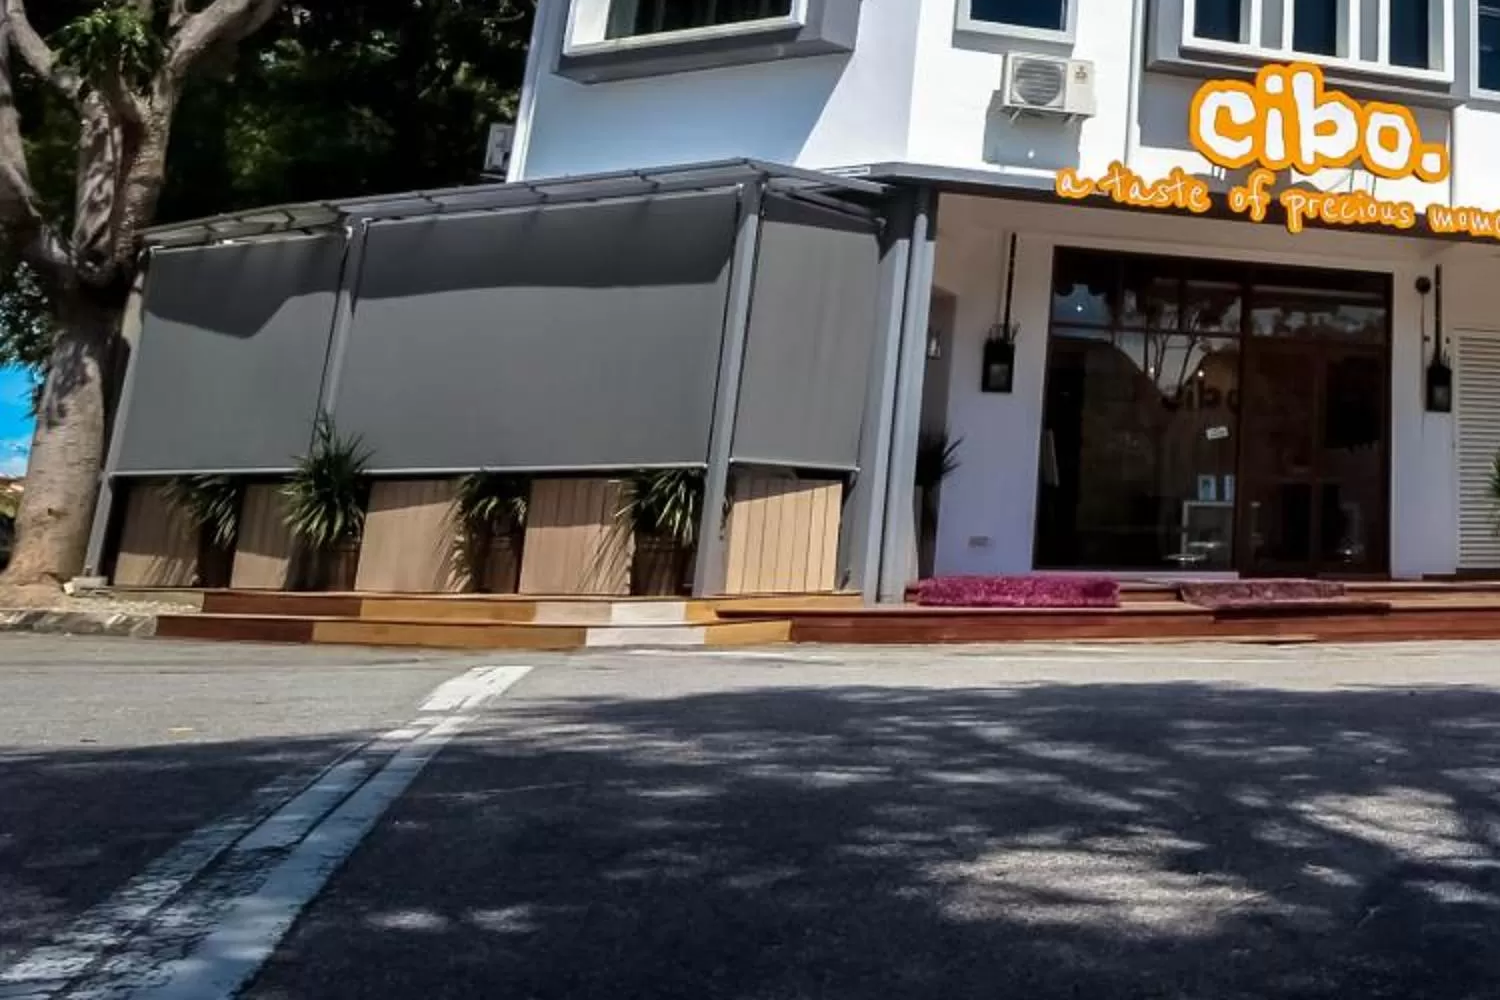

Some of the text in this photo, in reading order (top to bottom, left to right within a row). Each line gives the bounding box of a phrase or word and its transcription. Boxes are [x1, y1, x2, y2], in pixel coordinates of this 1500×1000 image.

[1058, 171, 1087, 199] a
[1105, 165, 1208, 210] taste
[1230, 173, 1274, 221] of
[1286, 191, 1414, 232] precious
